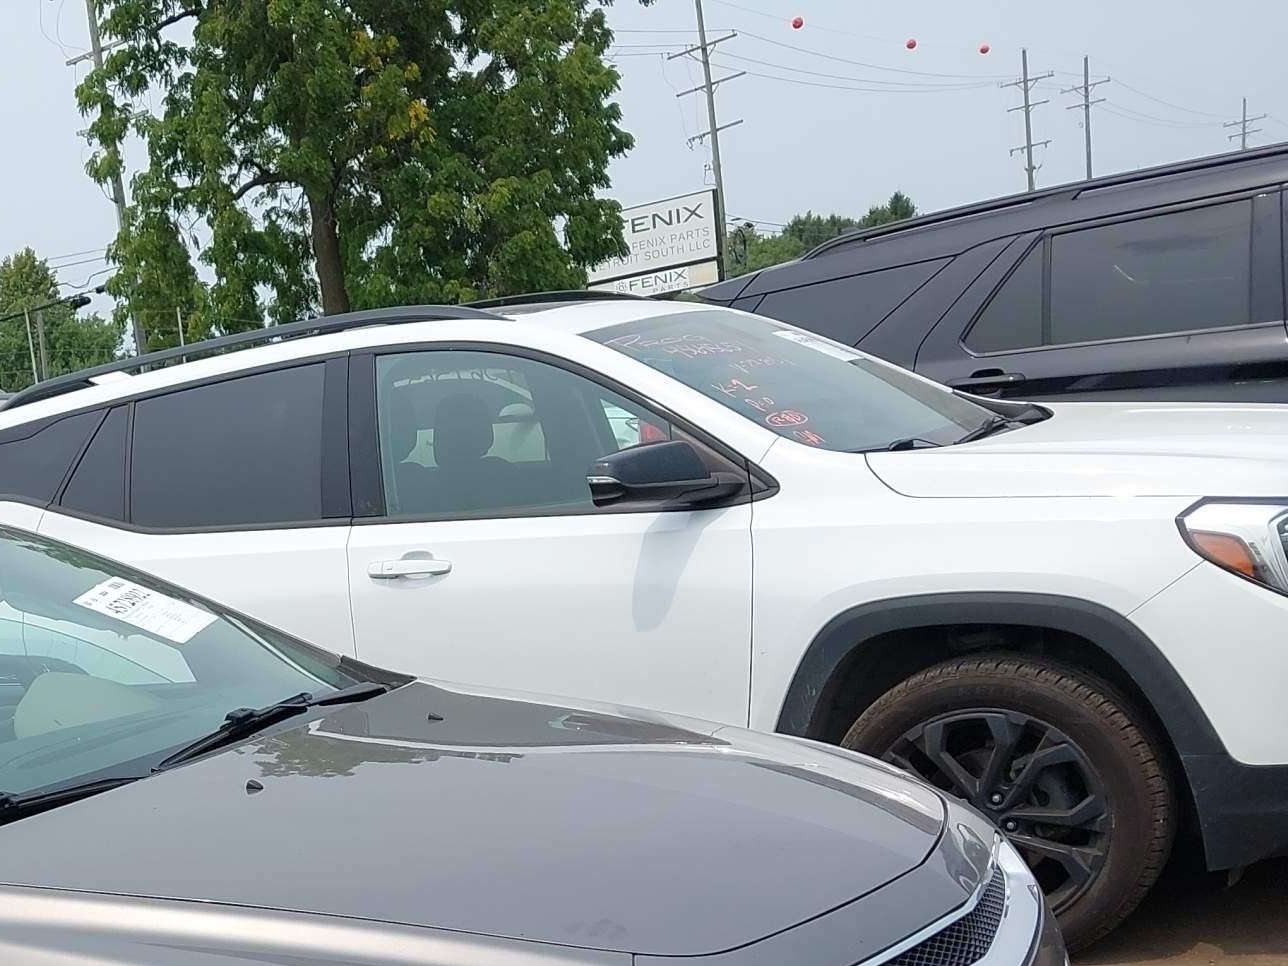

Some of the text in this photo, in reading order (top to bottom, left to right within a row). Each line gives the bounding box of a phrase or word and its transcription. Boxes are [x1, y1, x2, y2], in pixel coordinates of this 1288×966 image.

[631, 226, 710, 252] FENIX PARTS
[643, 245, 685, 261] SOUTH
[688, 238, 711, 253] LLC
[628, 268, 688, 292] FENIX
